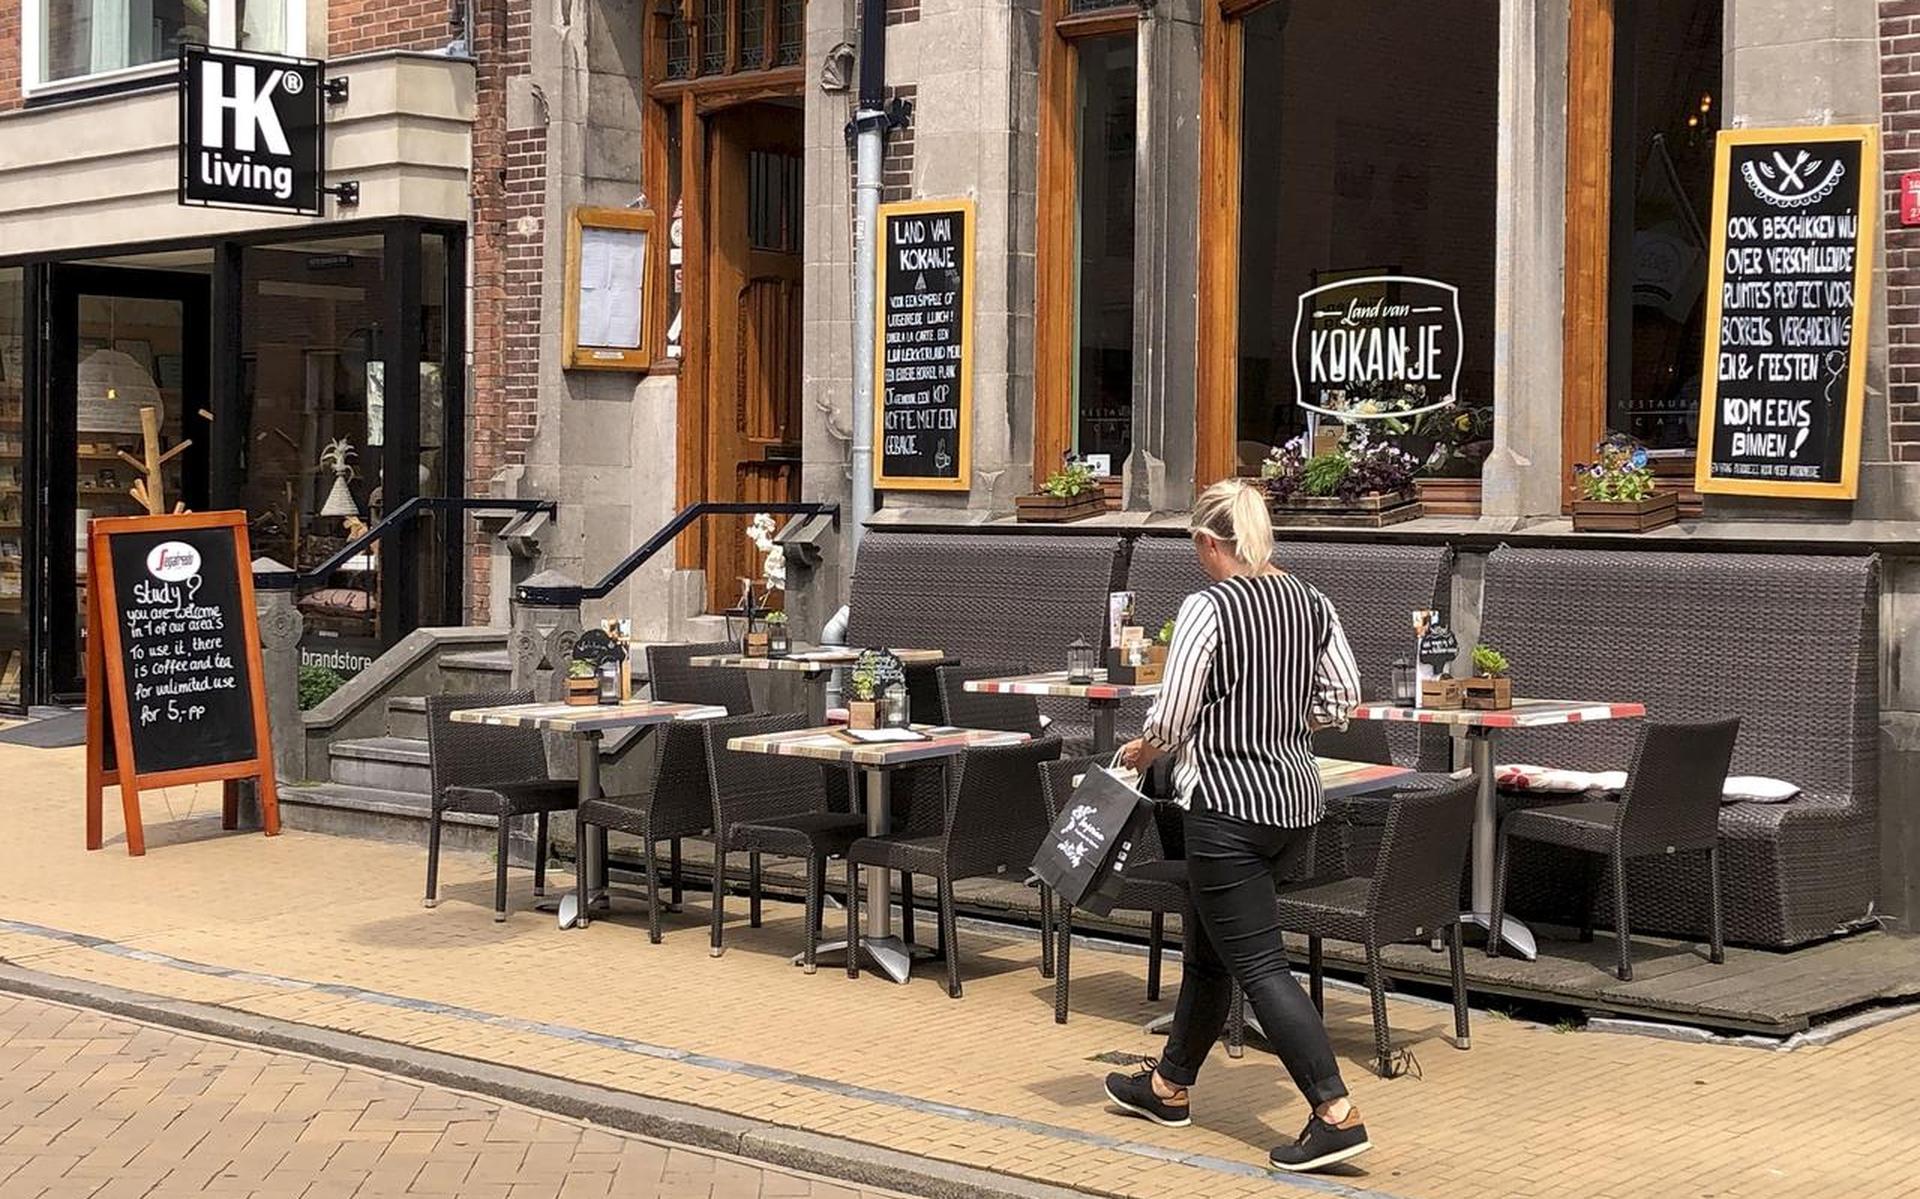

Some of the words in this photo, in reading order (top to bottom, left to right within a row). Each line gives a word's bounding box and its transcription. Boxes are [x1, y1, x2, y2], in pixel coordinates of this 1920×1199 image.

[202, 152, 292, 199] living
[895, 221, 925, 245] LAND
[930, 218, 951, 242] VAN
[1728, 216, 1759, 240] OOK
[900, 246, 955, 271] KOKANJE
[1726, 247, 1763, 275] OVER
[1766, 240, 1855, 274] VERSCHILLENDE
[944, 291, 956, 305] OF
[1724, 276, 1772, 309] RUIMTES
[1774, 281, 1823, 309] PERFECT
[1824, 281, 1854, 308] VOOR
[1341, 297, 1385, 326] Land
[1382, 304, 1410, 317] van
[1721, 316, 1774, 346] BORRELS
[1779, 309, 1851, 346] VERGADERING
[1310, 325, 1443, 383] KOKANJE
[1758, 353, 1819, 381] FEESTEN
[1723, 398, 1762, 426] KOM
[1765, 399, 1812, 427] EENS
[126, 608, 149, 628] you
[150, 608, 170, 620] are
[174, 603, 222, 620] welcome
[131, 626, 144, 638] in
[154, 621, 167, 636] of
[169, 622, 185, 633] our
[130, 644, 145, 660] To
[148, 644, 171, 657] use
[192, 637, 223, 651] there
[302, 646, 372, 671] brandstore
[134, 664, 148, 678] is
[152, 659, 190, 675] coffee
[190, 655, 213, 670] and
[214, 652, 234, 669] tea
[134, 683, 153, 701] for
[156, 676, 213, 696] unlimited
[213, 676, 236, 688] use
[140, 704, 161, 727] for
